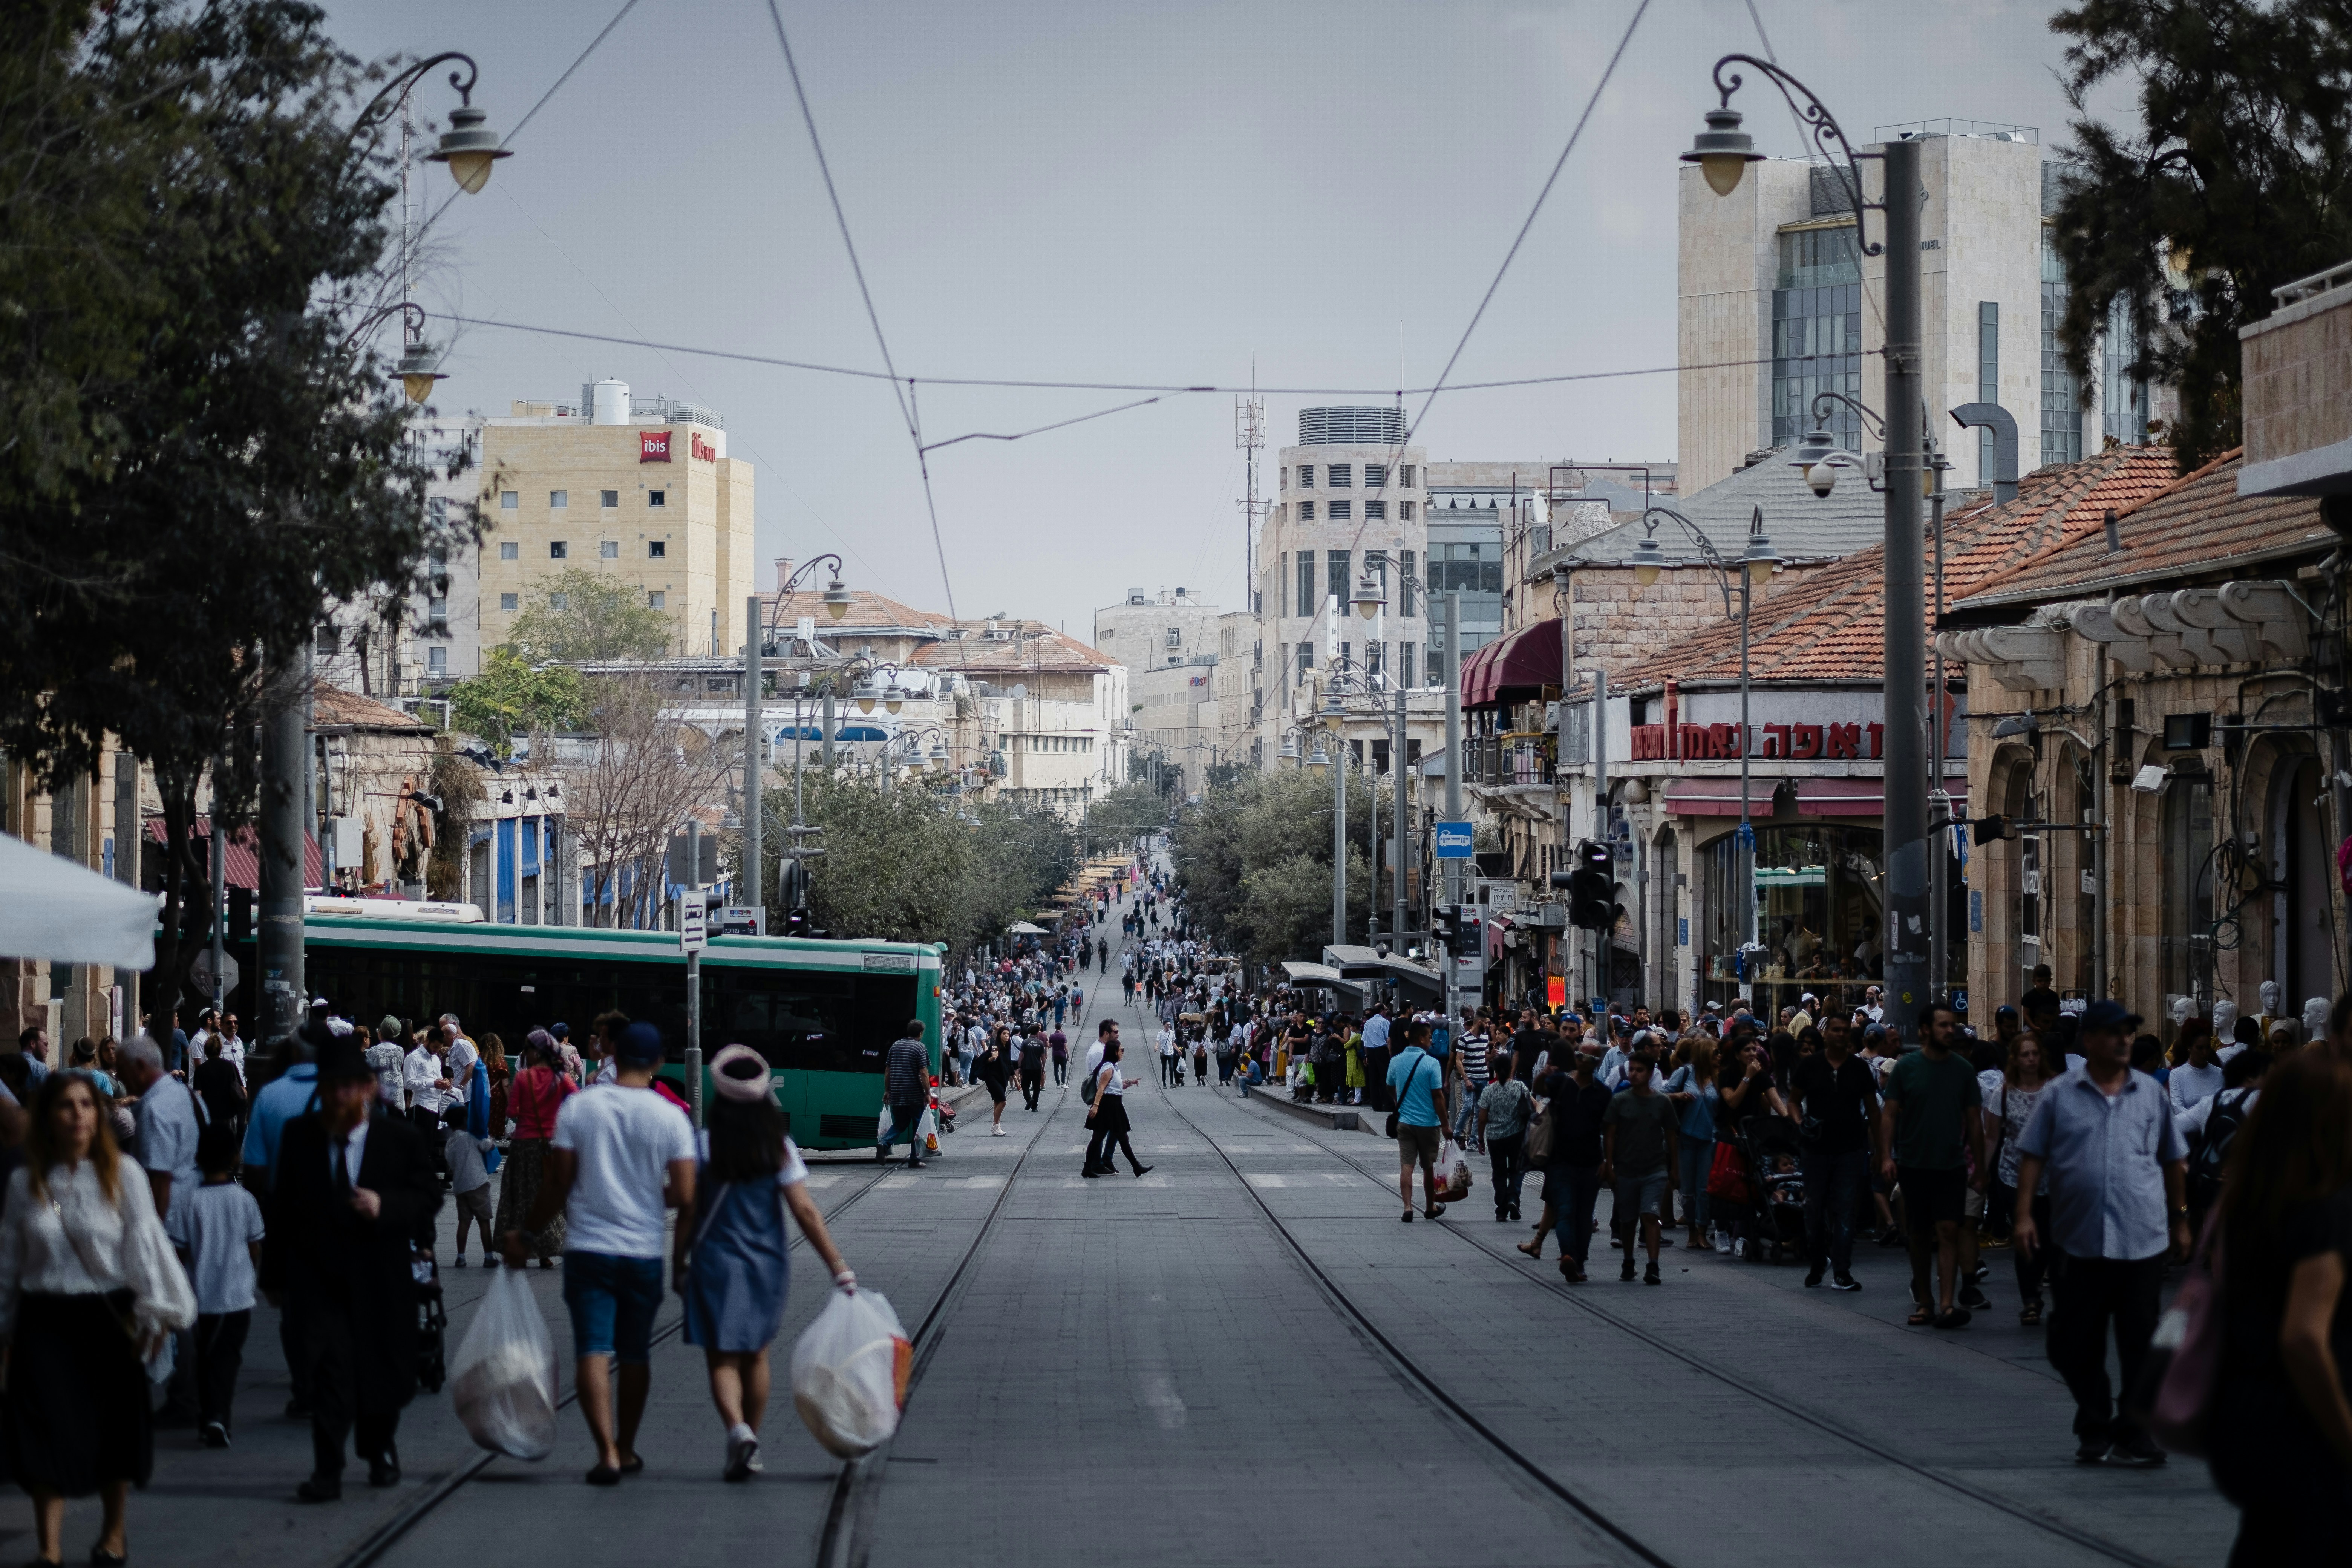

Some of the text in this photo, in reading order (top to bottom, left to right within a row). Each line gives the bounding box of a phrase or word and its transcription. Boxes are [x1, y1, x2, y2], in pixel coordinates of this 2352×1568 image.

[645, 440, 666, 452] ibis
[692, 432, 704, 459] ibis
[1190, 676, 1207, 687] POST
[1678, 722, 1752, 766] נאמן
